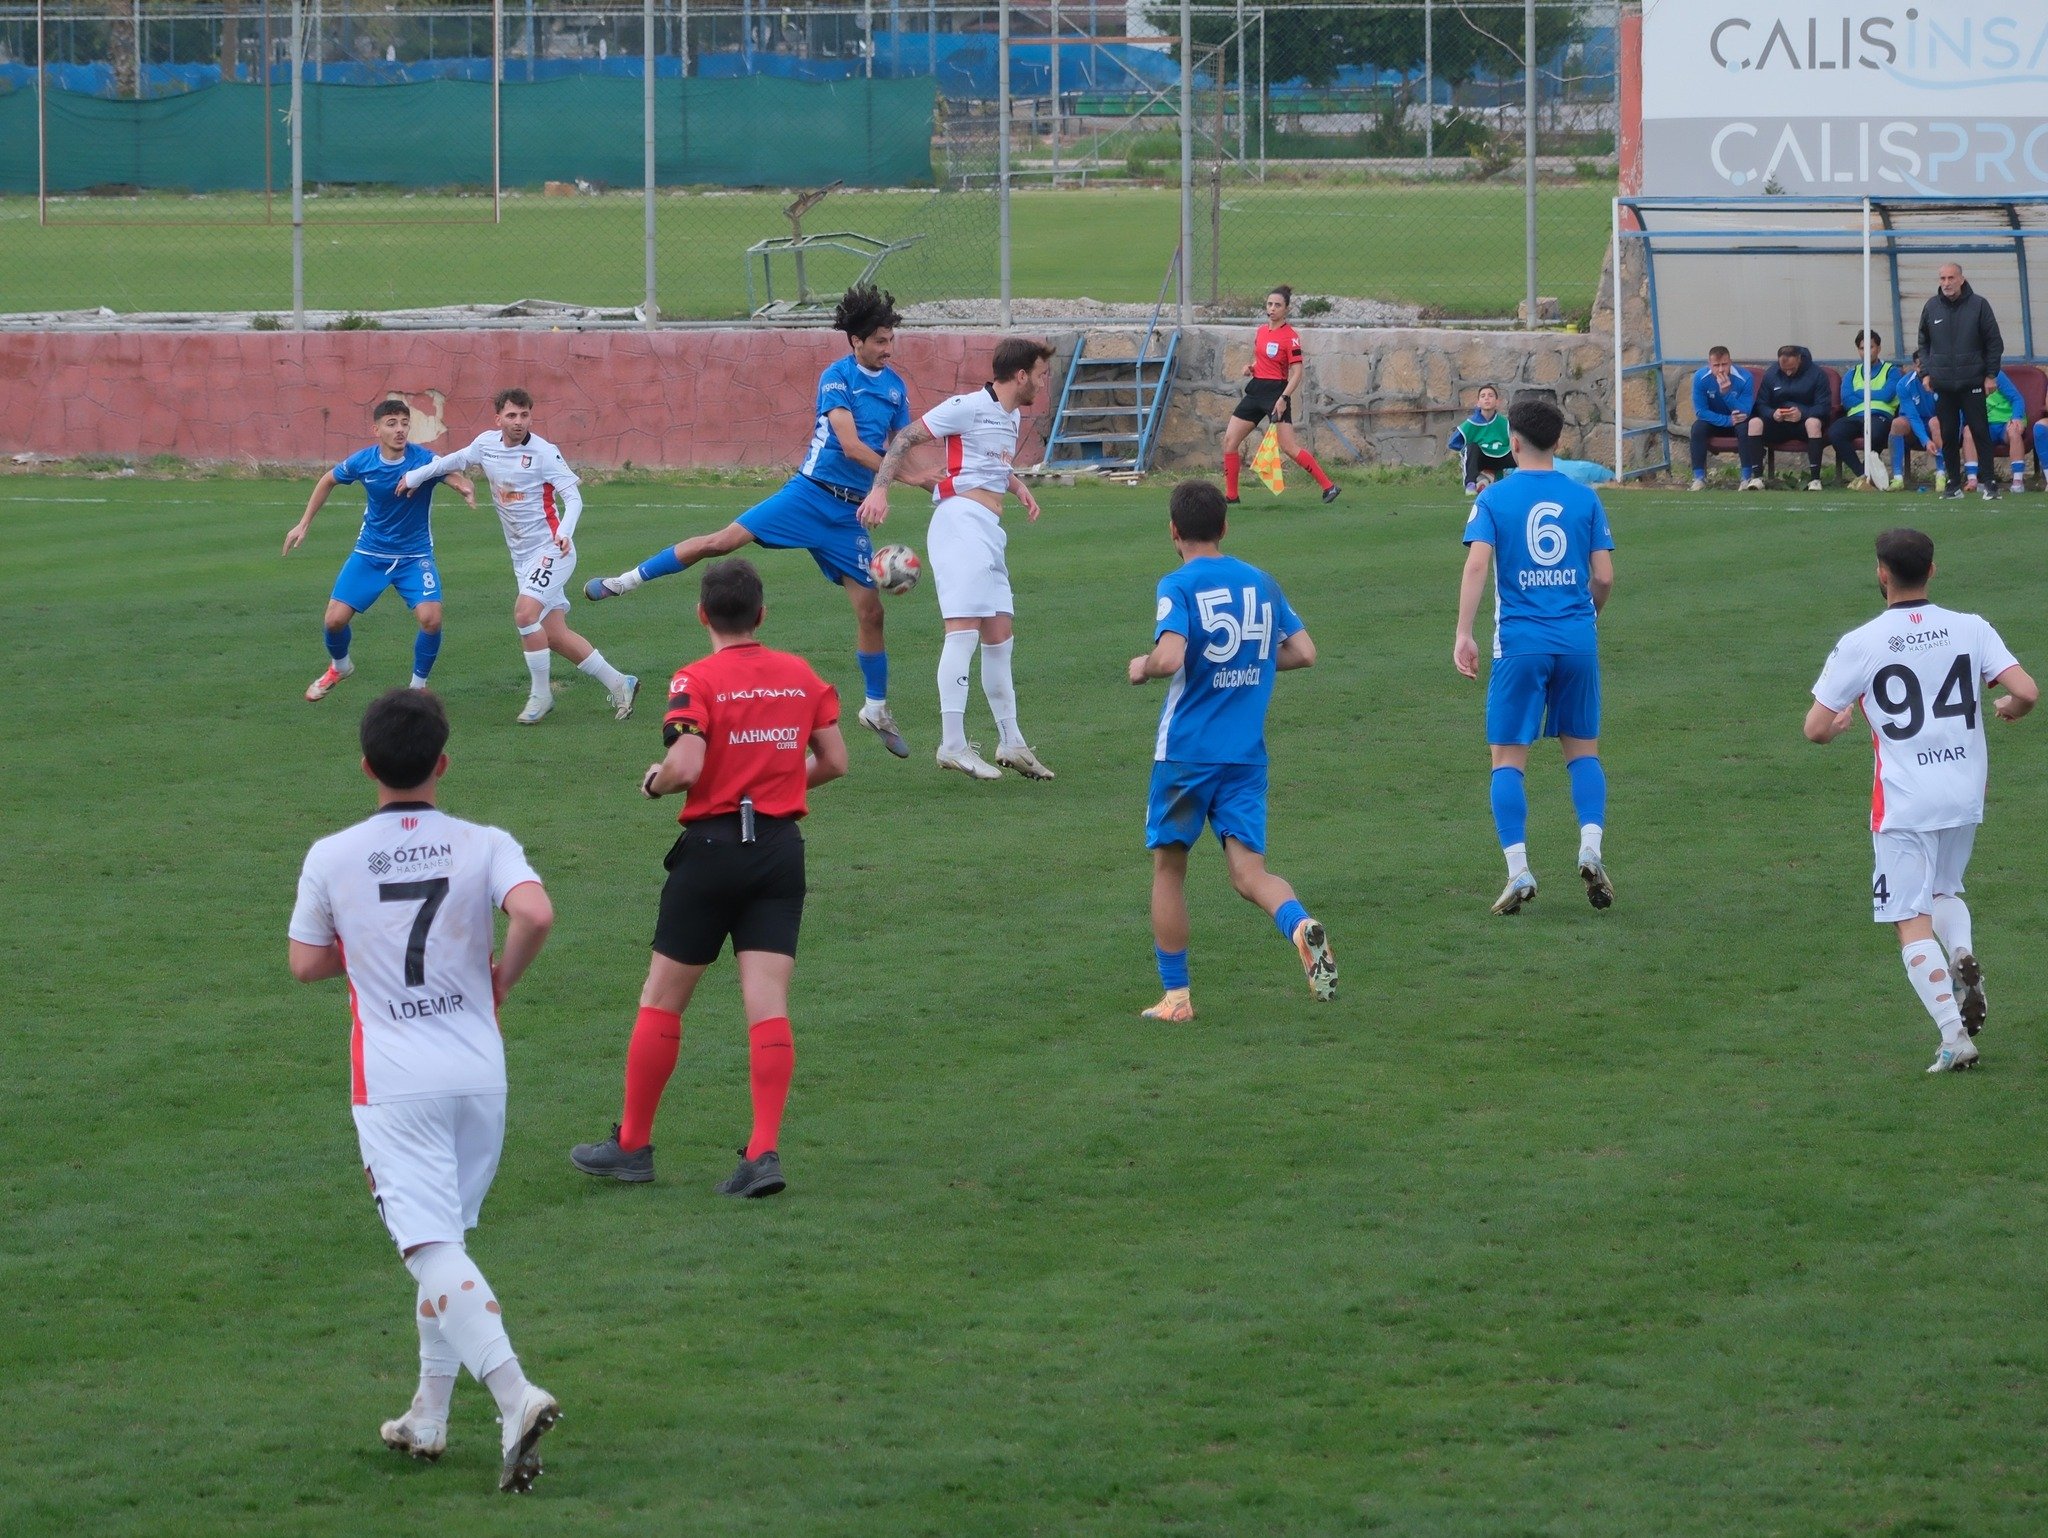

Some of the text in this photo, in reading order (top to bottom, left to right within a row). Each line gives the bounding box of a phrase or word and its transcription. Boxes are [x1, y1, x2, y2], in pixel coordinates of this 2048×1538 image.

[1526, 502, 1567, 566] 6
[422, 572, 436, 589] 8
[529, 568, 553, 588] 45
[1519, 569, 1577, 590] ÇARKACI
[1195, 586, 1273, 664] 54
[1906, 628, 1949, 645] ÖZTAN
[731, 688, 806, 700] KUTAHYA
[1872, 653, 1977, 741] 94
[776, 741, 798, 751] COFFEE
[1917, 746, 1967, 767] DİYAR
[393, 843, 452, 864] ÖZTAN
[378, 876, 450, 988] 7
[388, 992, 465, 1022] İ.DEMİR
